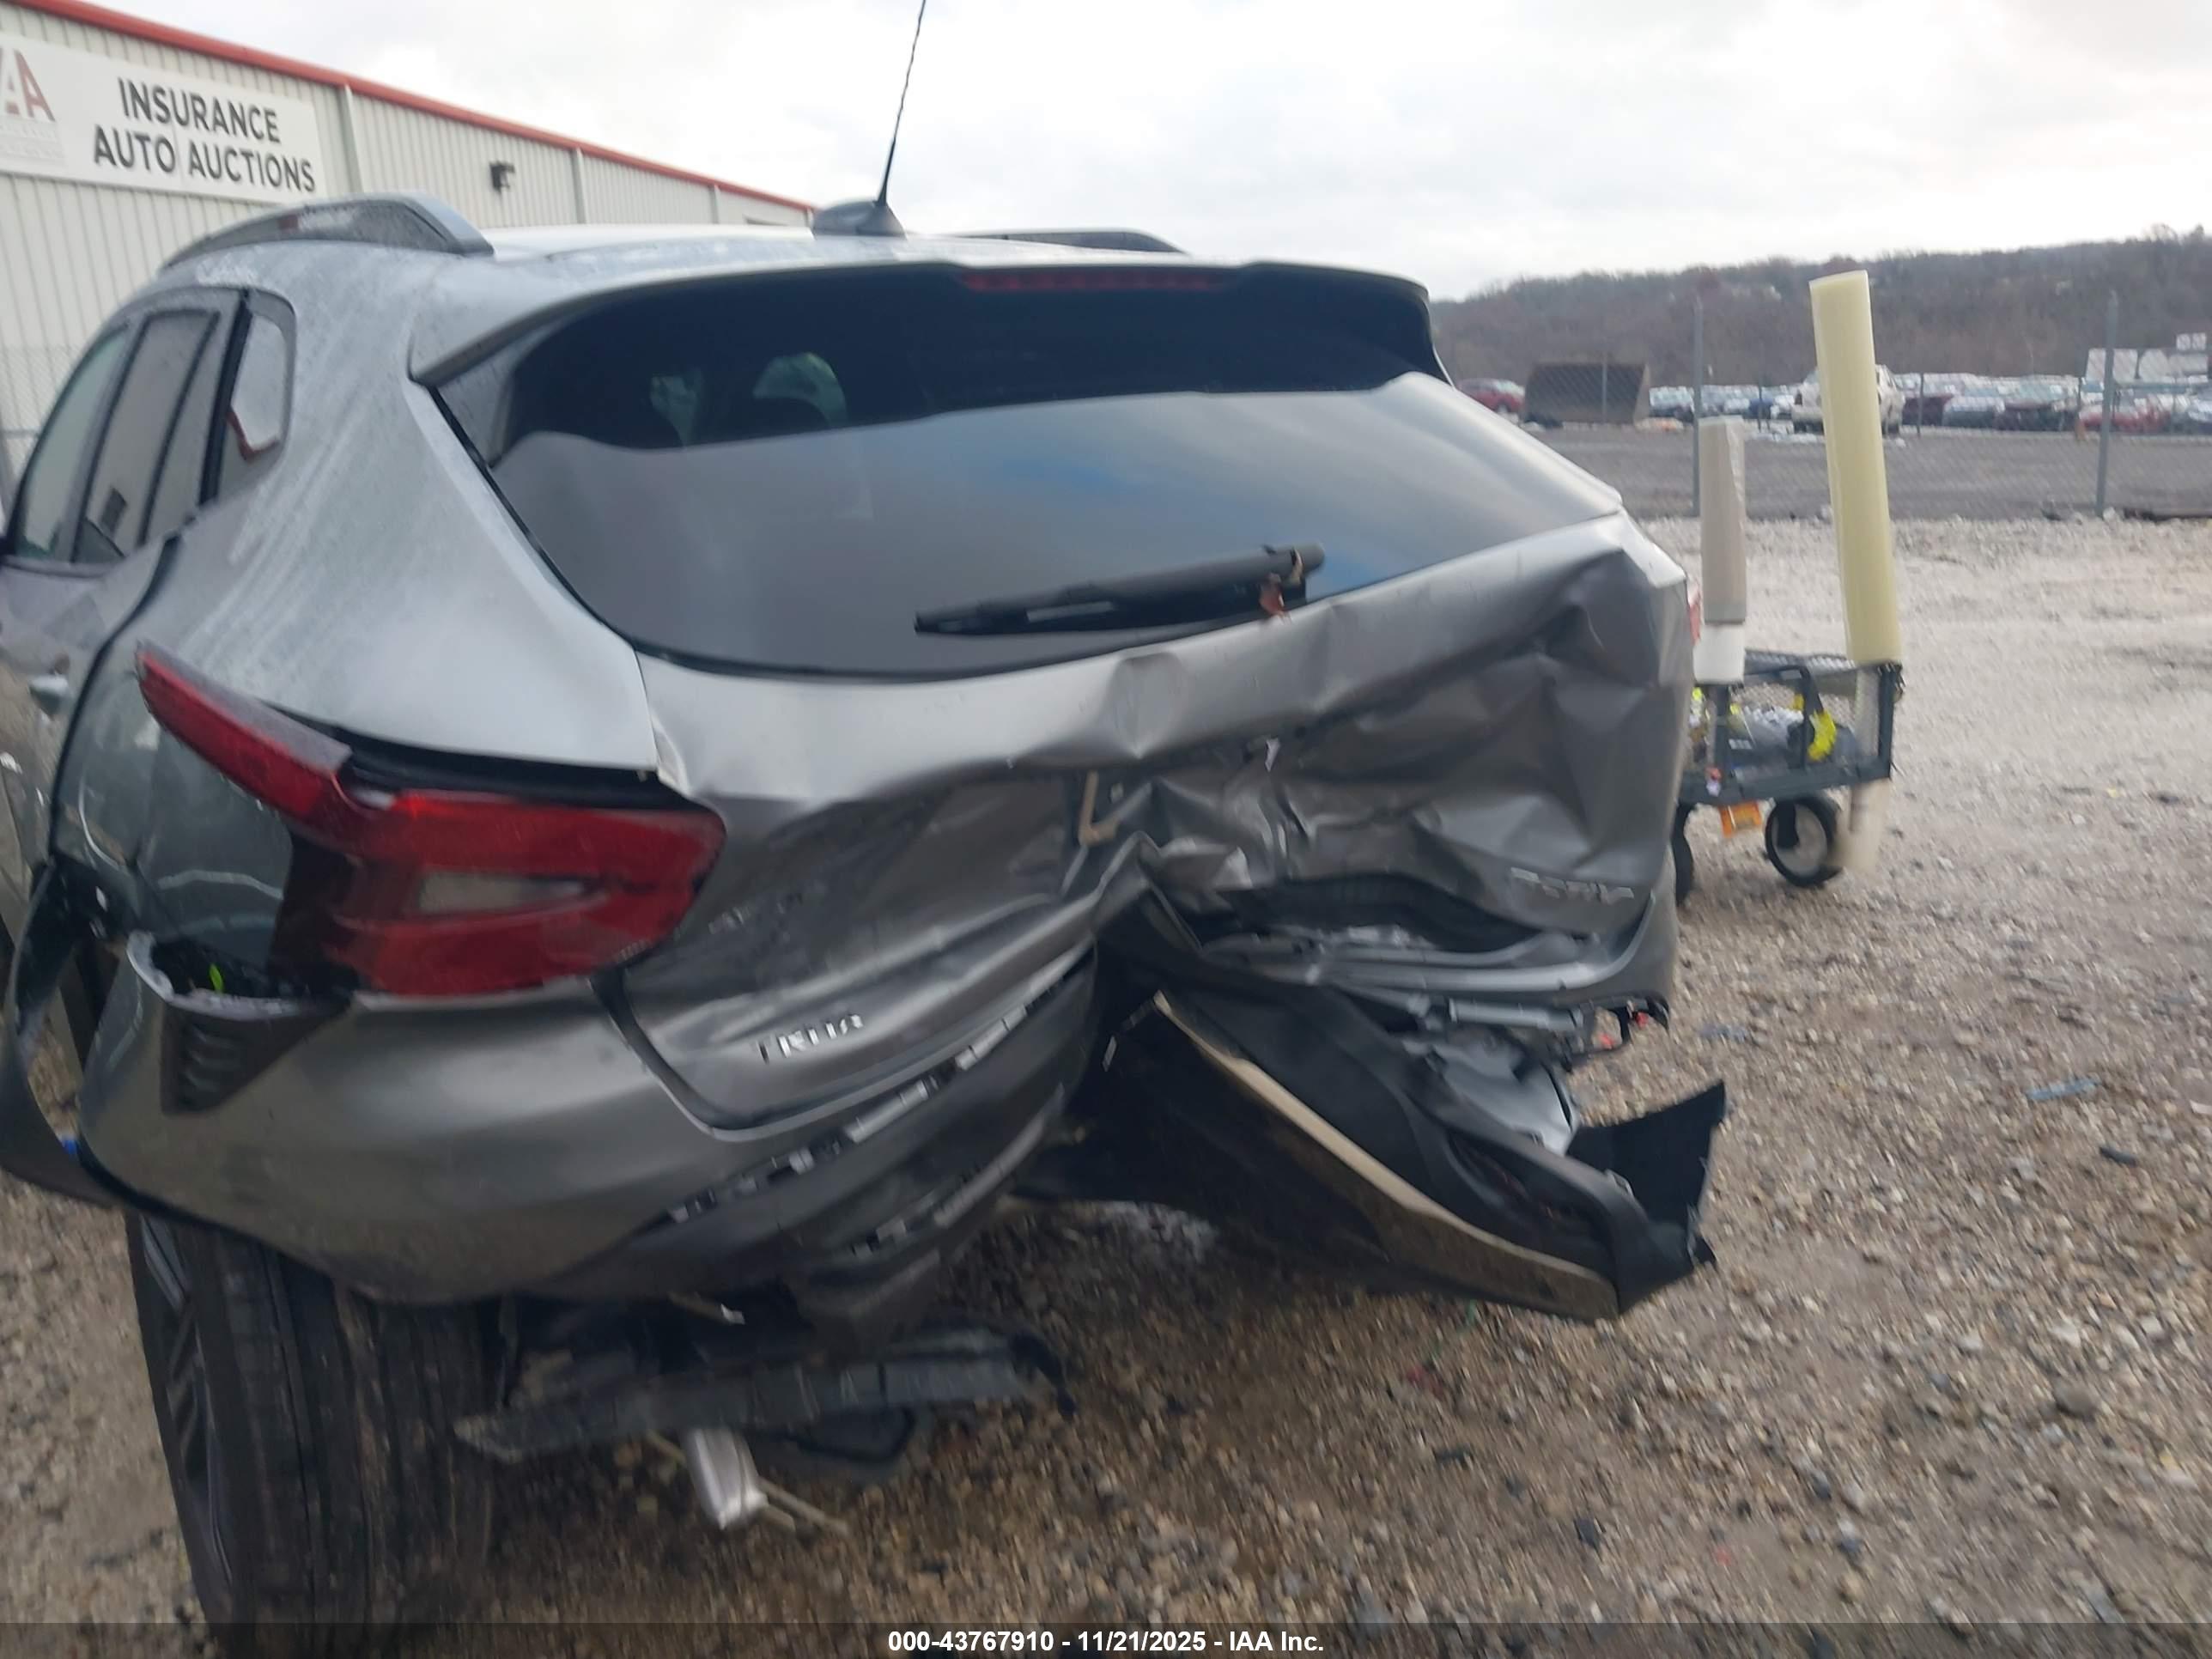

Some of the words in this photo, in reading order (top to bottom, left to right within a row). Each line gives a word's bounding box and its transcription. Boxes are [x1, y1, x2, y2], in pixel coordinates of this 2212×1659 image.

[118, 77, 280, 143] INSURANCE
[94, 124, 176, 173] AUTO
[188, 140, 316, 192] AUCTIONS
